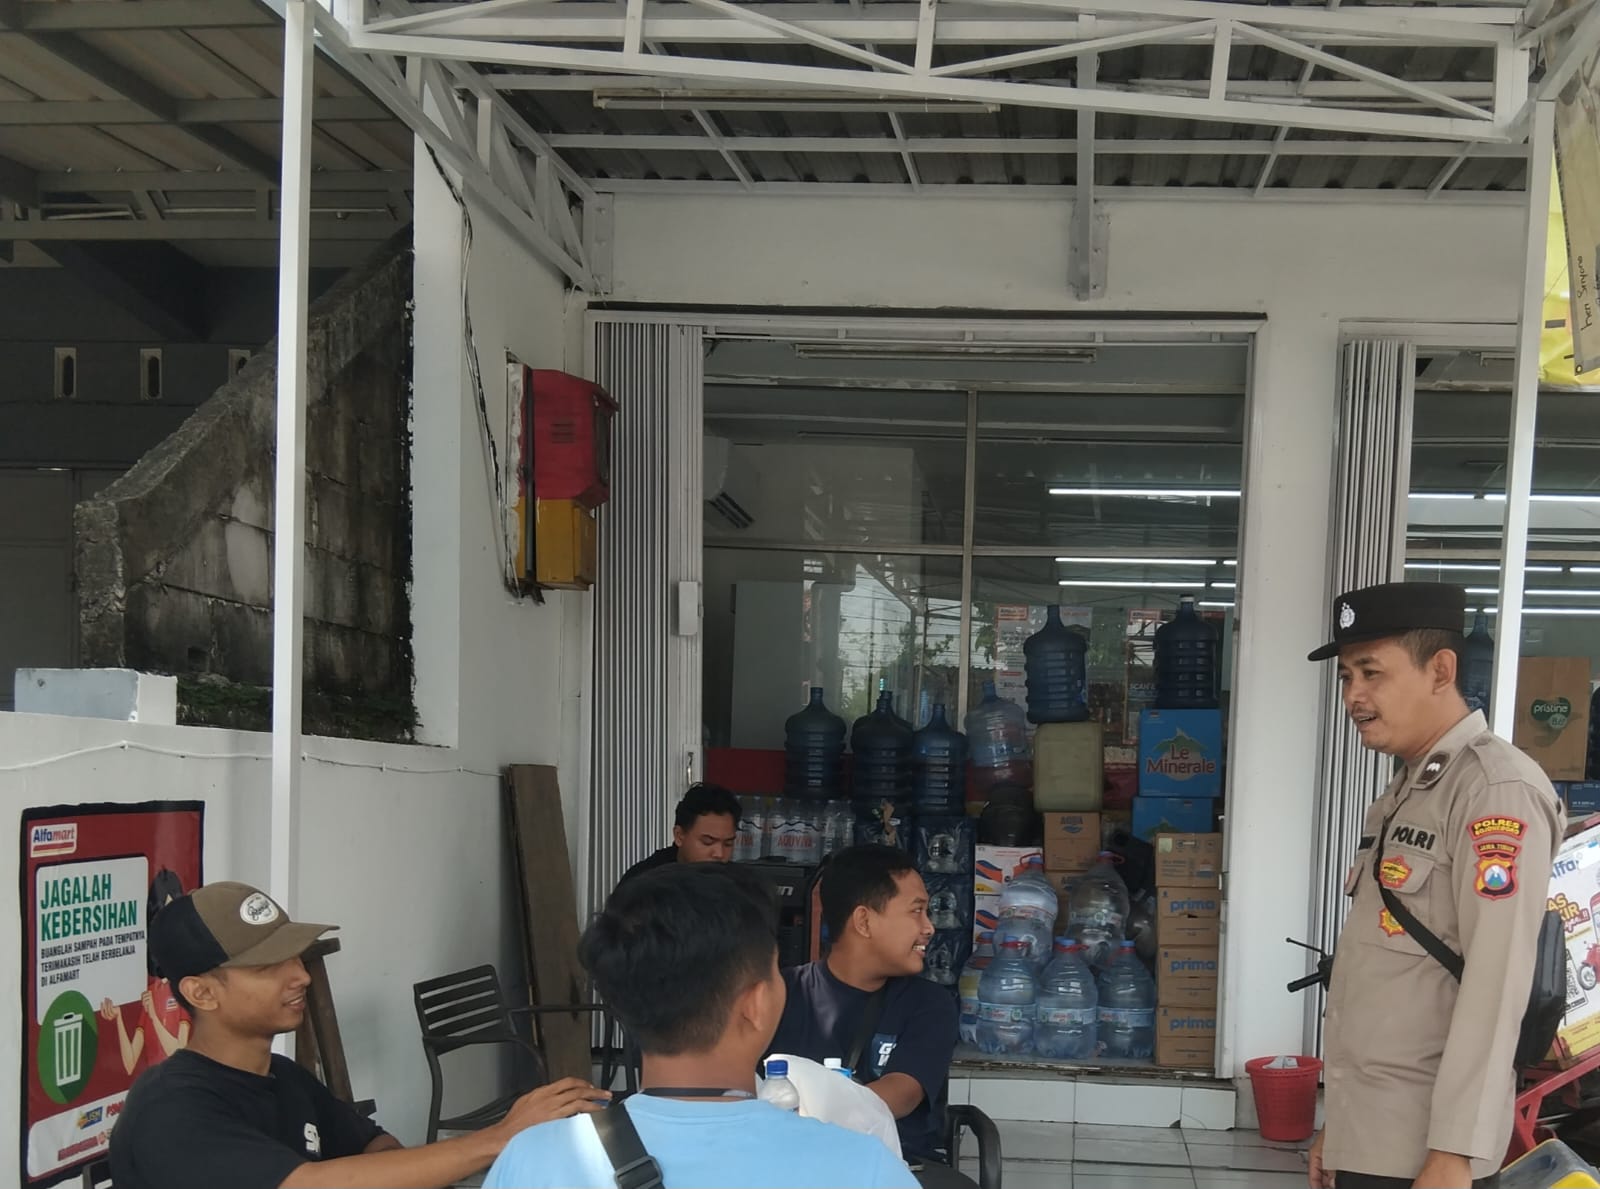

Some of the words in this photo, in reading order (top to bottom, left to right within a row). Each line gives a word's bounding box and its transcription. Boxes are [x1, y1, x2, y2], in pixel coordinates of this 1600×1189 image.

[1533, 703, 1569, 714] pristine
[1170, 743, 1190, 760] Le
[1146, 756, 1217, 775] Minerale
[1060, 816, 1084, 825] AQUA
[1473, 818, 1520, 830] POLRES
[33, 827, 75, 843] Alfamart
[41, 873, 112, 909] JAGALAH
[1170, 898, 1216, 913] prima
[41, 900, 138, 942] KEBERSIHAN
[41, 943, 73, 959] BUANGLAH
[74, 937, 98, 953] SAMPAH
[99, 934, 114, 948] PADA
[115, 930, 145, 945] TEMPATNYA
[41, 954, 81, 973] TERIMAKASIH
[82, 951, 100, 965] TELAH
[101, 944, 136, 960] BERBELANJA
[1170, 958, 1217, 973] prima
[41, 976, 48, 987] DI
[49, 969, 80, 985] ALFAMART
[1169, 1016, 1217, 1031] prima
